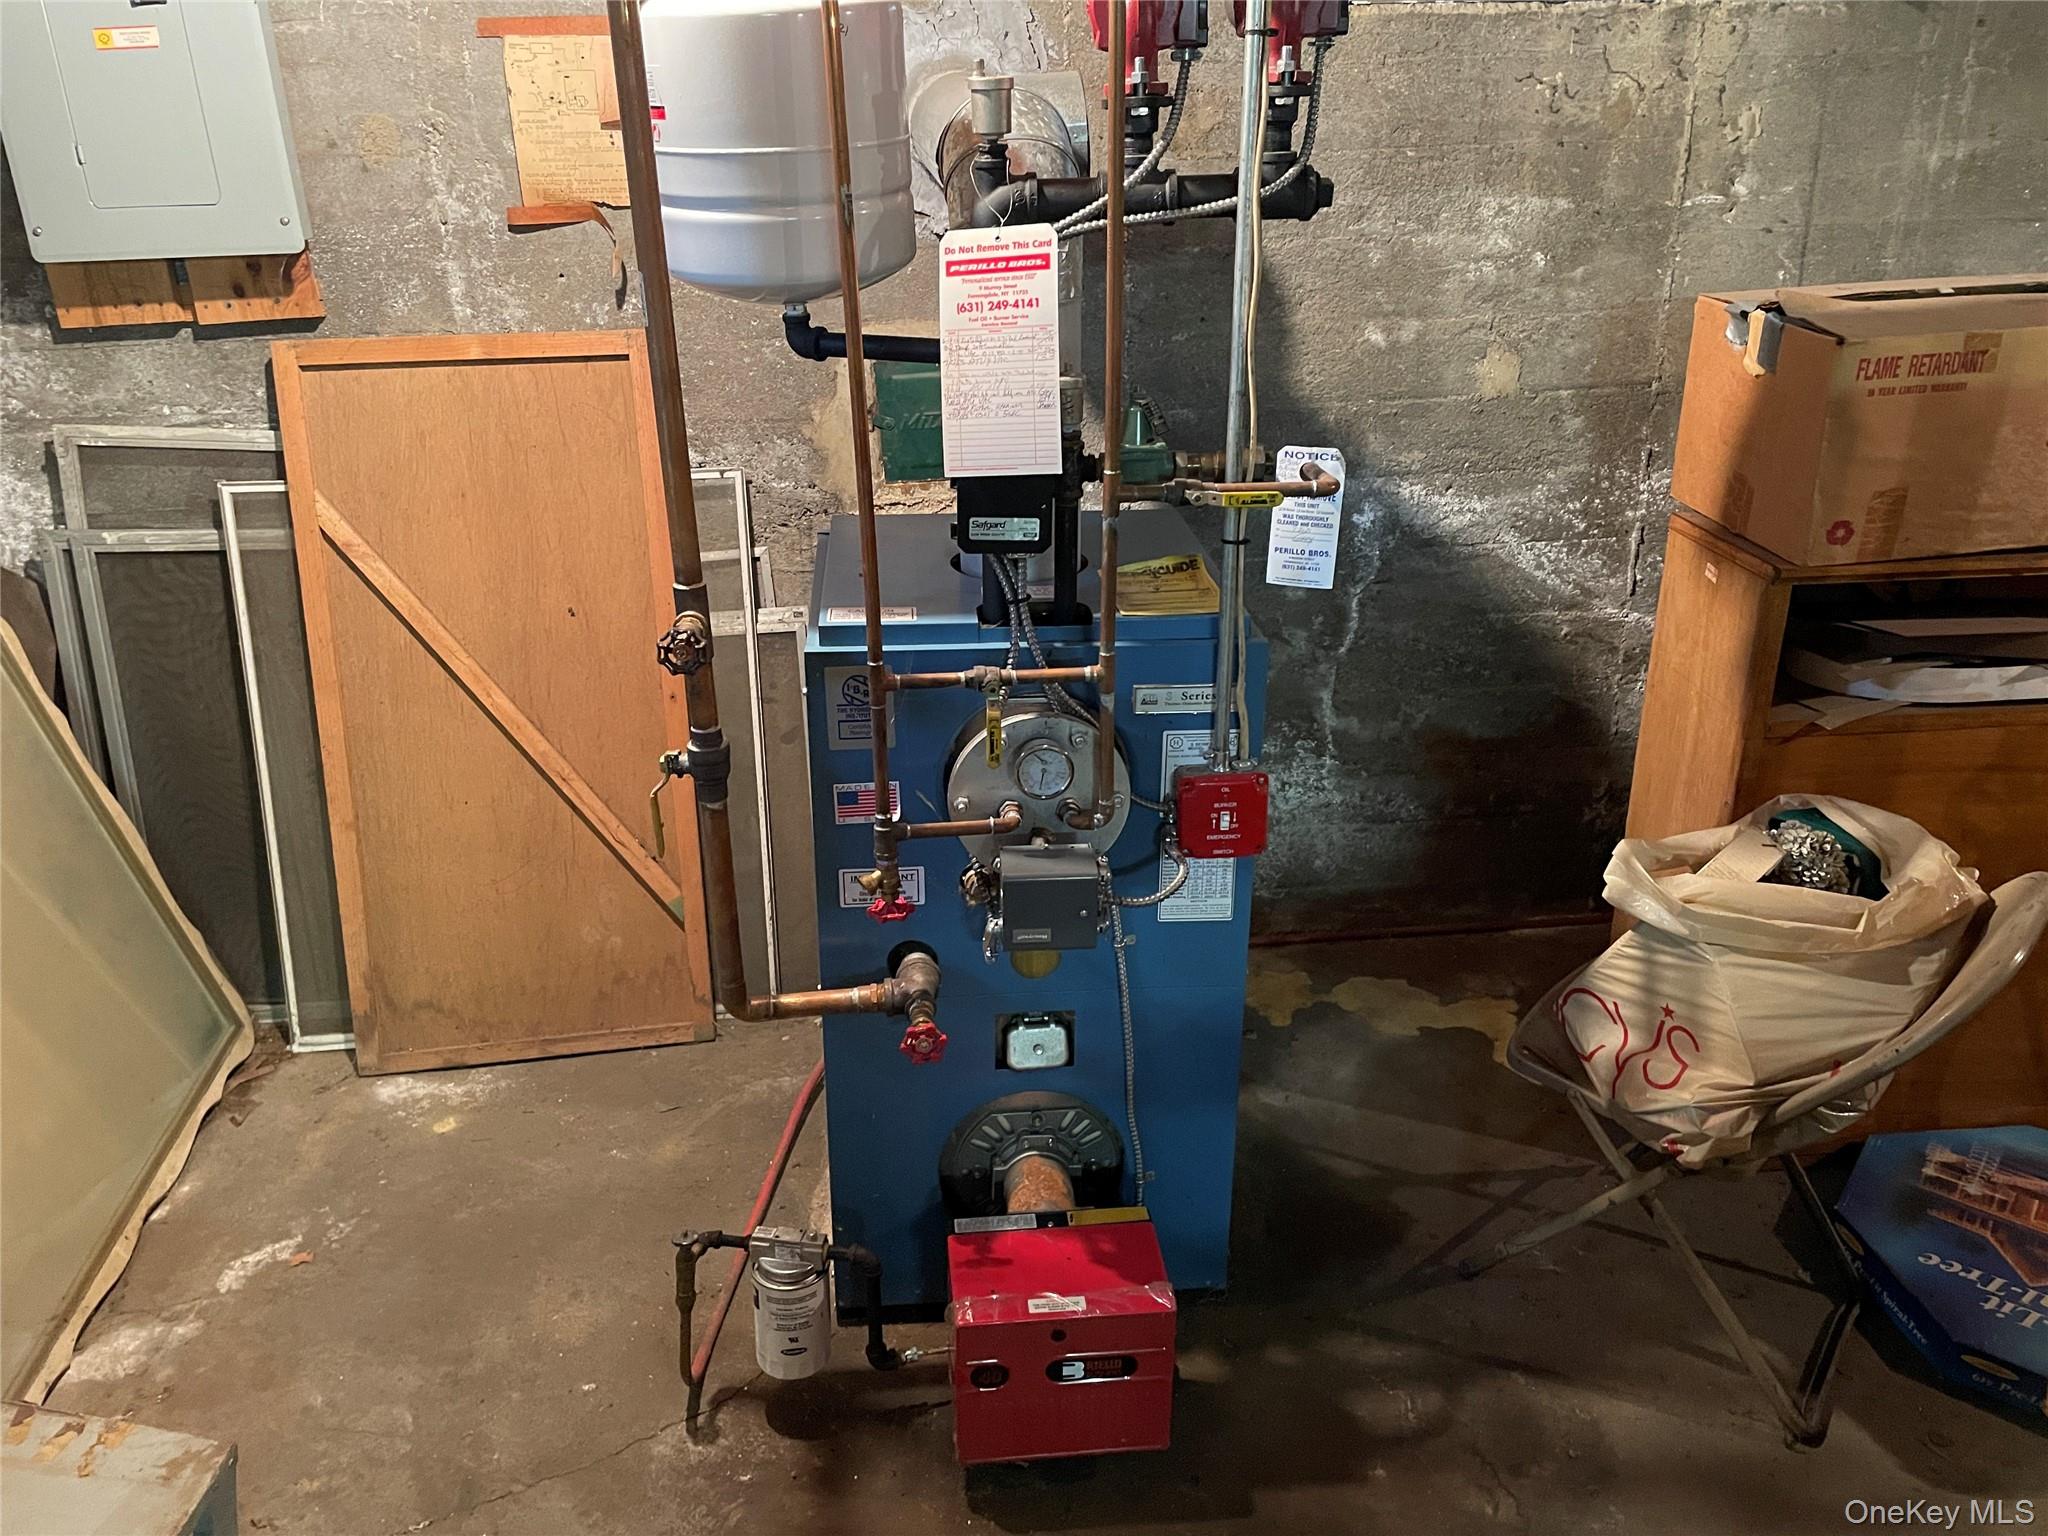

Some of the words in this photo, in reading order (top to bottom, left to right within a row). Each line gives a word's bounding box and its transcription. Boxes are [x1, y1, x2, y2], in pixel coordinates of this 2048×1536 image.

[944, 247, 956, 256] Do
[958, 246, 974, 255] Not
[976, 243, 1010, 253] Remove
[1012, 240, 1030, 249] This
[1032, 238, 1052, 248] Card
[950, 261, 1007, 273] PERILLO
[1008, 258, 1046, 269] BROS.
[956, 301, 984, 315] (631)
[987, 297, 1040, 312] 249-4141
[1855, 355, 1904, 382] FLAME
[1907, 348, 1990, 378] RETARDANT
[1878, 386, 1896, 397] YEAR
[1898, 384, 1928, 395] LIMITED
[1930, 381, 1969, 393] WARRANTY
[1284, 450, 1340, 462] NOTICE
[1276, 519, 1299, 527] CLEANED
[1310, 521, 1334, 529] CHECKED
[1295, 514, 1331, 523] THOROUGHLY
[970, 520, 1007, 531] Safgard
[1274, 546, 1306, 556] PERILLO
[1308, 549, 1332, 558] BROS.
[1181, 690, 1217, 701] Series
[1213, 801, 1238, 809] BURNER
[1206, 833, 1242, 841] EMERGENCY
